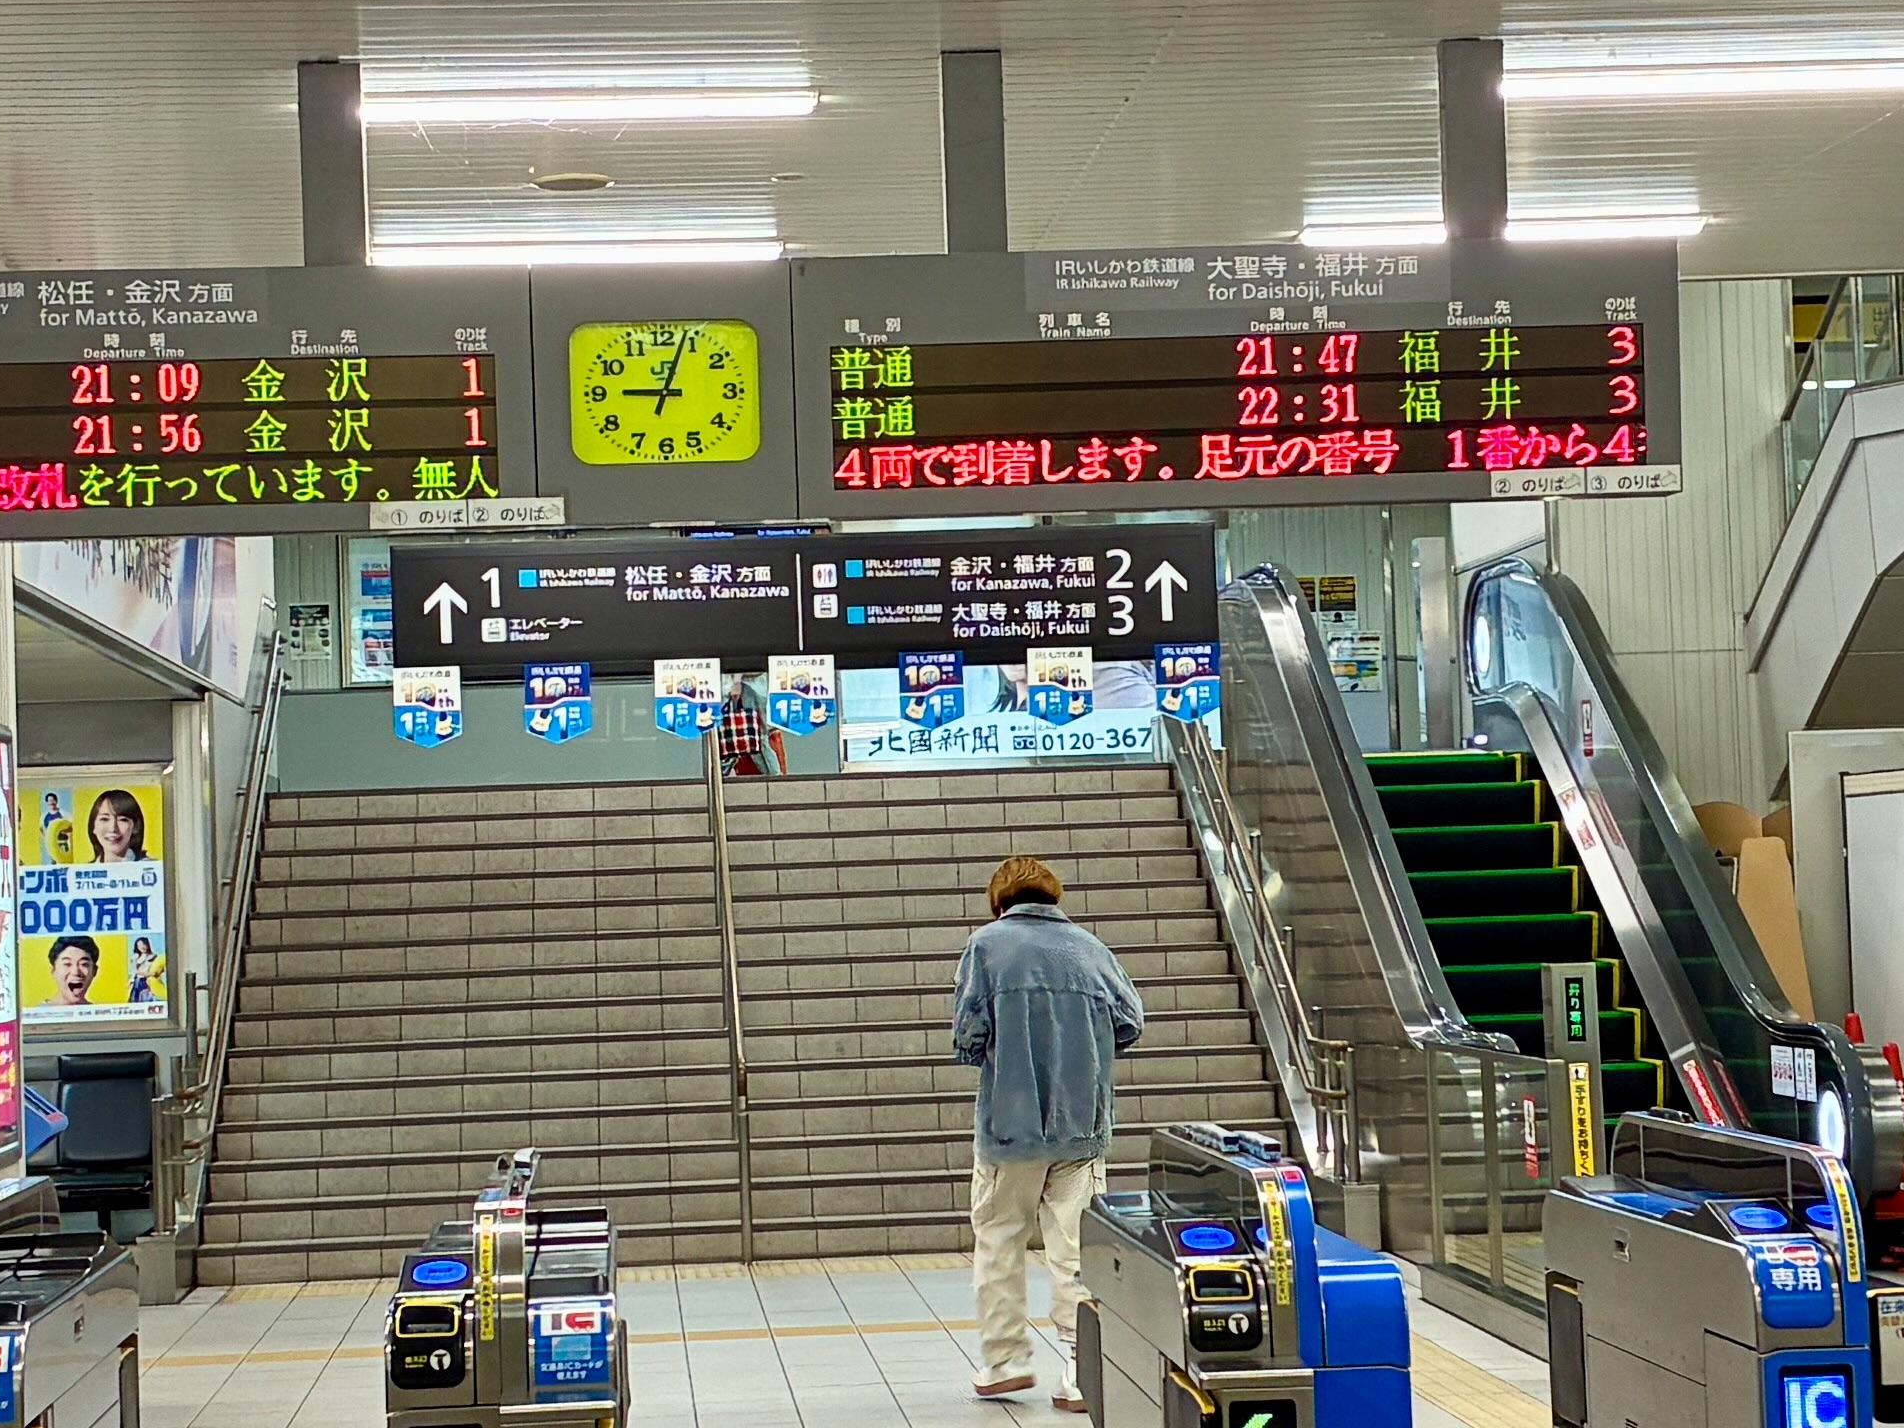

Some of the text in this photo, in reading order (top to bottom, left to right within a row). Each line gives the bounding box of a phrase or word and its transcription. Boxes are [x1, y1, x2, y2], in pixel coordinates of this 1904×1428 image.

[1208, 255, 1418, 281] 大聖寺・福井 方面
[38, 279, 233, 307] 松任・金沢 方面
[1209, 283, 1238, 300] for
[1330, 279, 1384, 297] Fukui
[40, 310, 69, 327] for
[153, 307, 257, 326] Kanazawa
[624, 340, 646, 357] 11
[650, 330, 676, 347] 12
[688, 336, 697, 353] 1
[1607, 326, 1636, 365] 3
[600, 359, 625, 376] 10
[709, 353, 725, 370] 2
[832, 345, 914, 391] 普通
[462, 357, 485, 398] 1
[591, 385, 608, 402] 9
[722, 383, 738, 400] 3
[1609, 375, 1637, 415] 3
[463, 406, 487, 447] 1
[603, 415, 620, 432] 8
[710, 412, 727, 429] 4
[833, 395, 915, 440] 普通
[631, 432, 646, 450] 7
[658, 437, 675, 455] 6
[686, 430, 702, 448] 5
[950, 555, 1056, 576] 金沢・福井
[1105, 548, 1134, 589] 2
[481, 567, 502, 609] 1
[952, 574, 1096, 591] for Kanazawa, Fukui
[625, 588, 650, 603] for
[710, 584, 789, 600] Kanazawa
[1108, 594, 1136, 636] 3
[953, 620, 1090, 639] for Fukui
[1042, 727, 1152, 752] 0120-367
[1770, 1268, 1823, 1294] 専用
